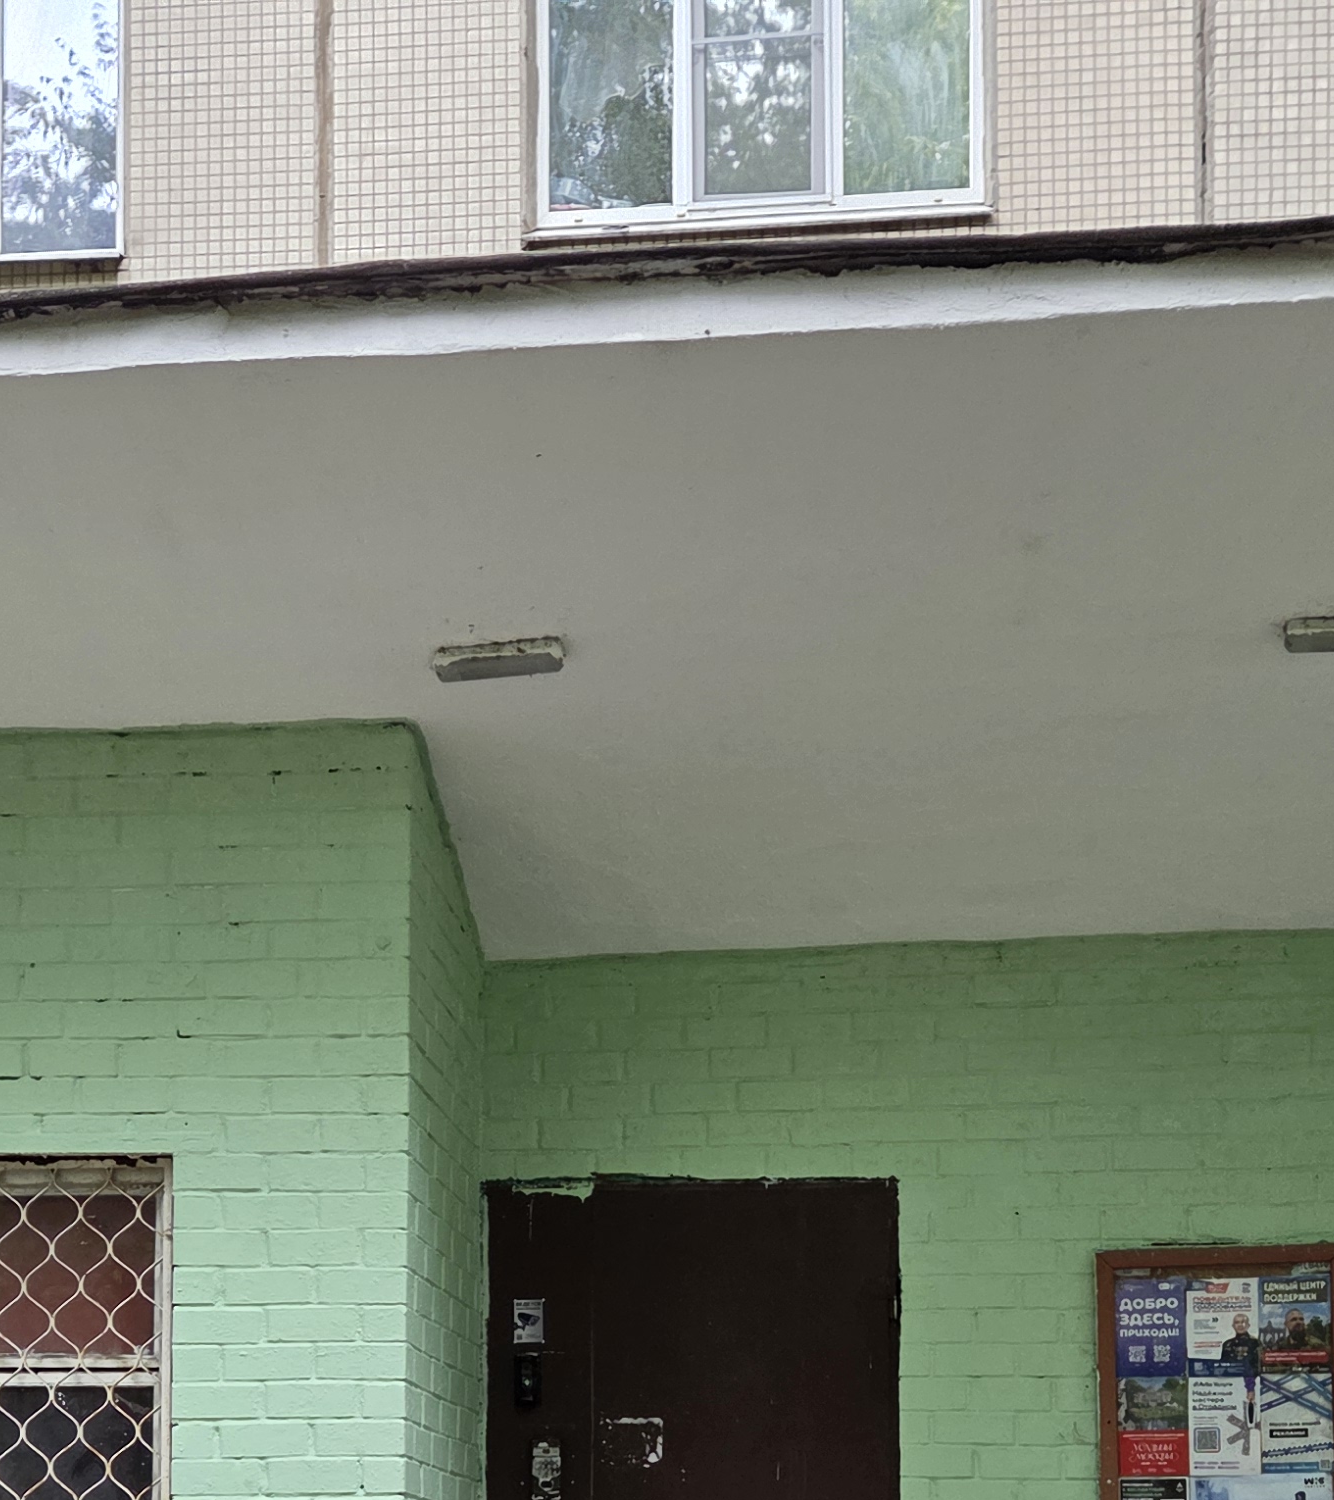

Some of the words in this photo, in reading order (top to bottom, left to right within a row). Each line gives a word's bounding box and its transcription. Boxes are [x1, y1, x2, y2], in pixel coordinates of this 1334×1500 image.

[1263, 1281, 1299, 1292] ЕДИНЫЙ
[1299, 1281, 1326, 1291] ЦЕНТР
[1263, 1293, 1317, 1302] ПОДДЕРЖКИ
[1119, 1297, 1179, 1312] ДОБРО
[1119, 1312, 1179, 1327] ЗДЕСЬ,
[1119, 1328, 1179, 1338] ПРИХОДИ!
